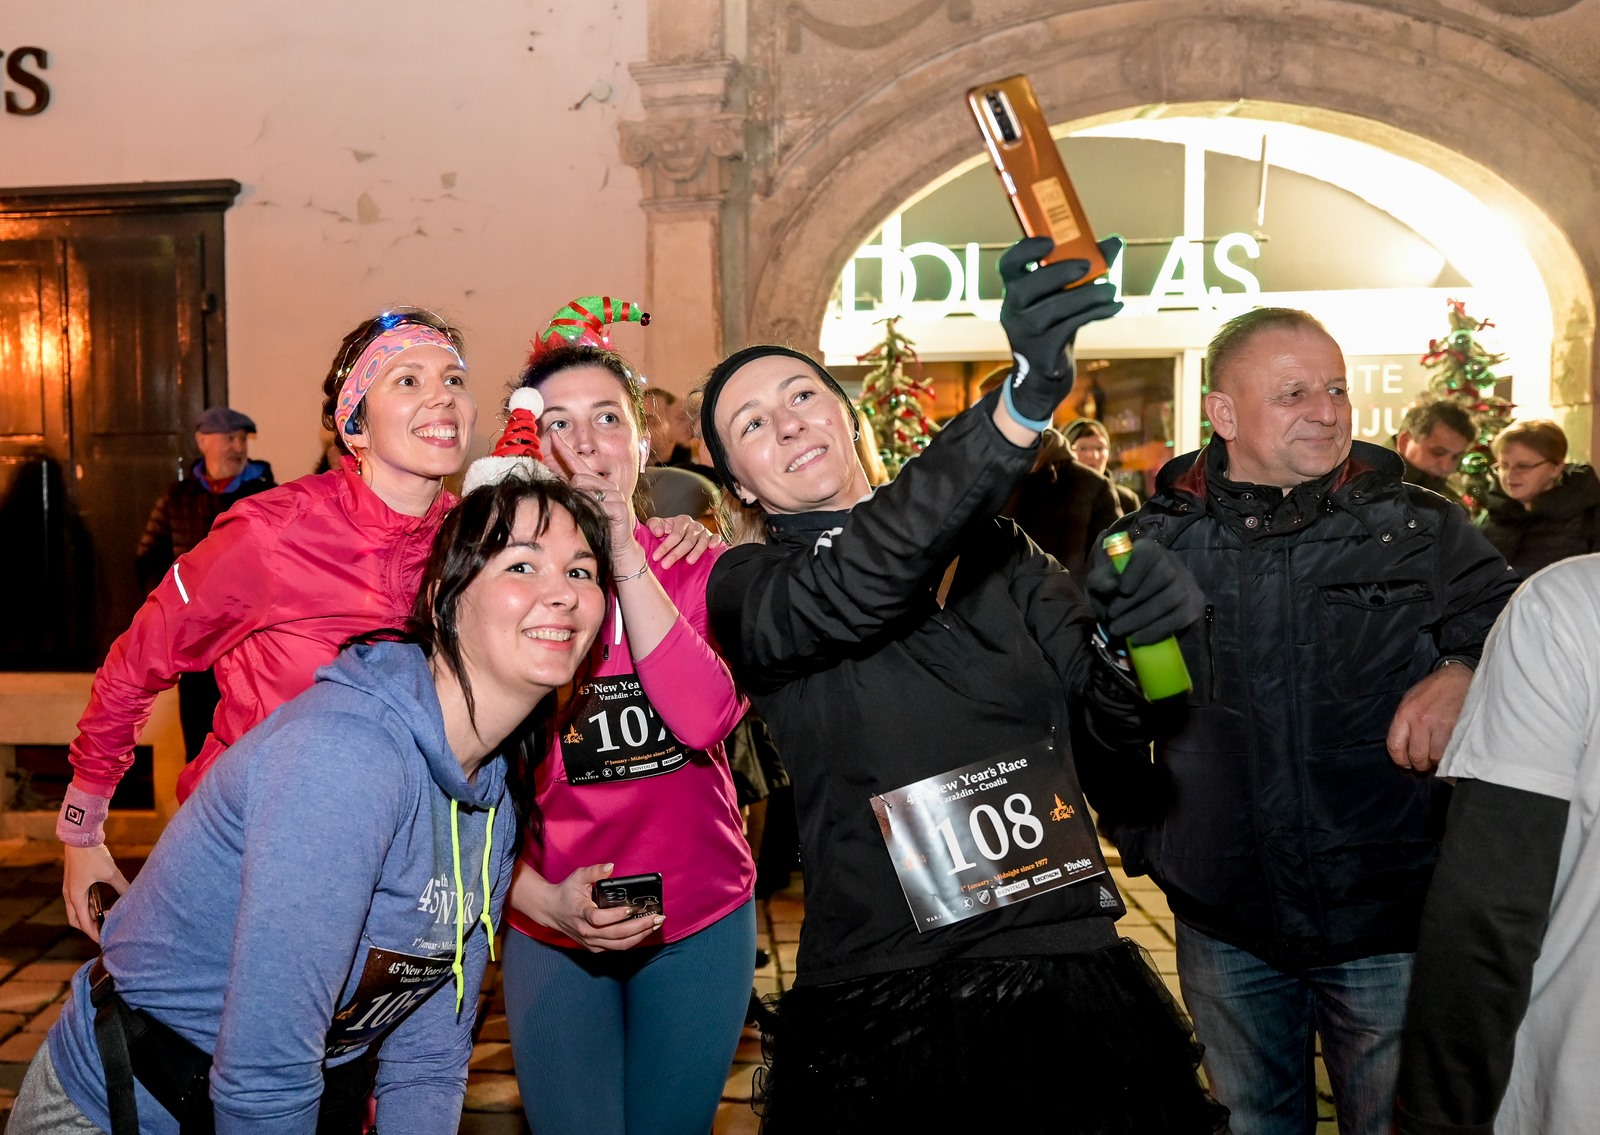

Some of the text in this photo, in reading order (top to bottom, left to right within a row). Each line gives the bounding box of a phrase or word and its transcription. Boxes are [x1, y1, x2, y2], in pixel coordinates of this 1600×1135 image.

[0, 46, 50, 116] S
[842, 231, 1262, 320] DOULAS
[594, 682, 618, 694] New
[619, 681, 640, 692] Yea
[653, 750, 666, 758] since
[959, 766, 998, 785] Year's
[997, 757, 1028, 775] Race
[978, 776, 1008, 791] Croatia
[931, 793, 1044, 877] 108
[966, 878, 990, 891] January
[993, 865, 1020, 883] Midnight
[1019, 863, 1035, 875] since
[1034, 857, 1048, 869] 1977
[402, 964, 423, 976] New
